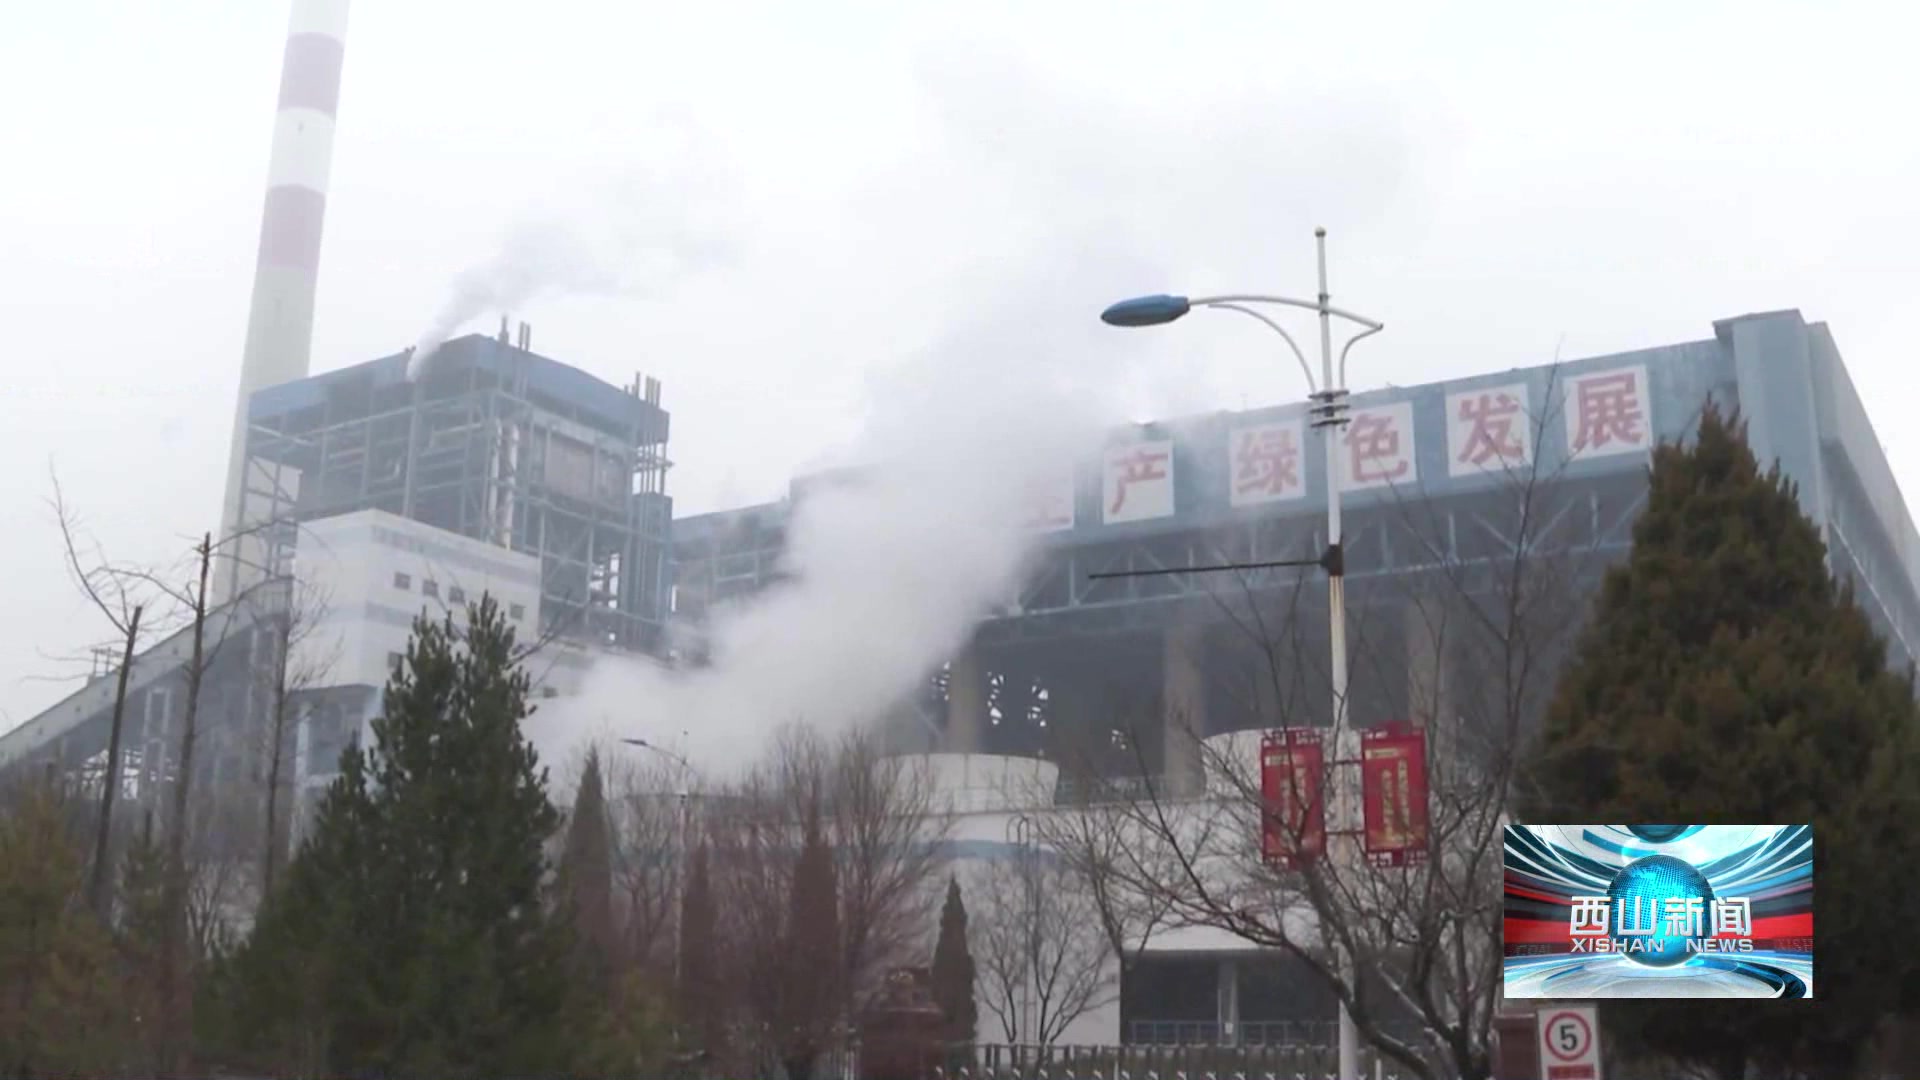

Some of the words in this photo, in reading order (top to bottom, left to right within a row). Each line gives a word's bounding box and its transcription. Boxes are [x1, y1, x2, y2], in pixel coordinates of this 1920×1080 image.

[1024, 371, 1644, 529] 产绿色发展
[1560, 1024, 1578, 1051] 5
